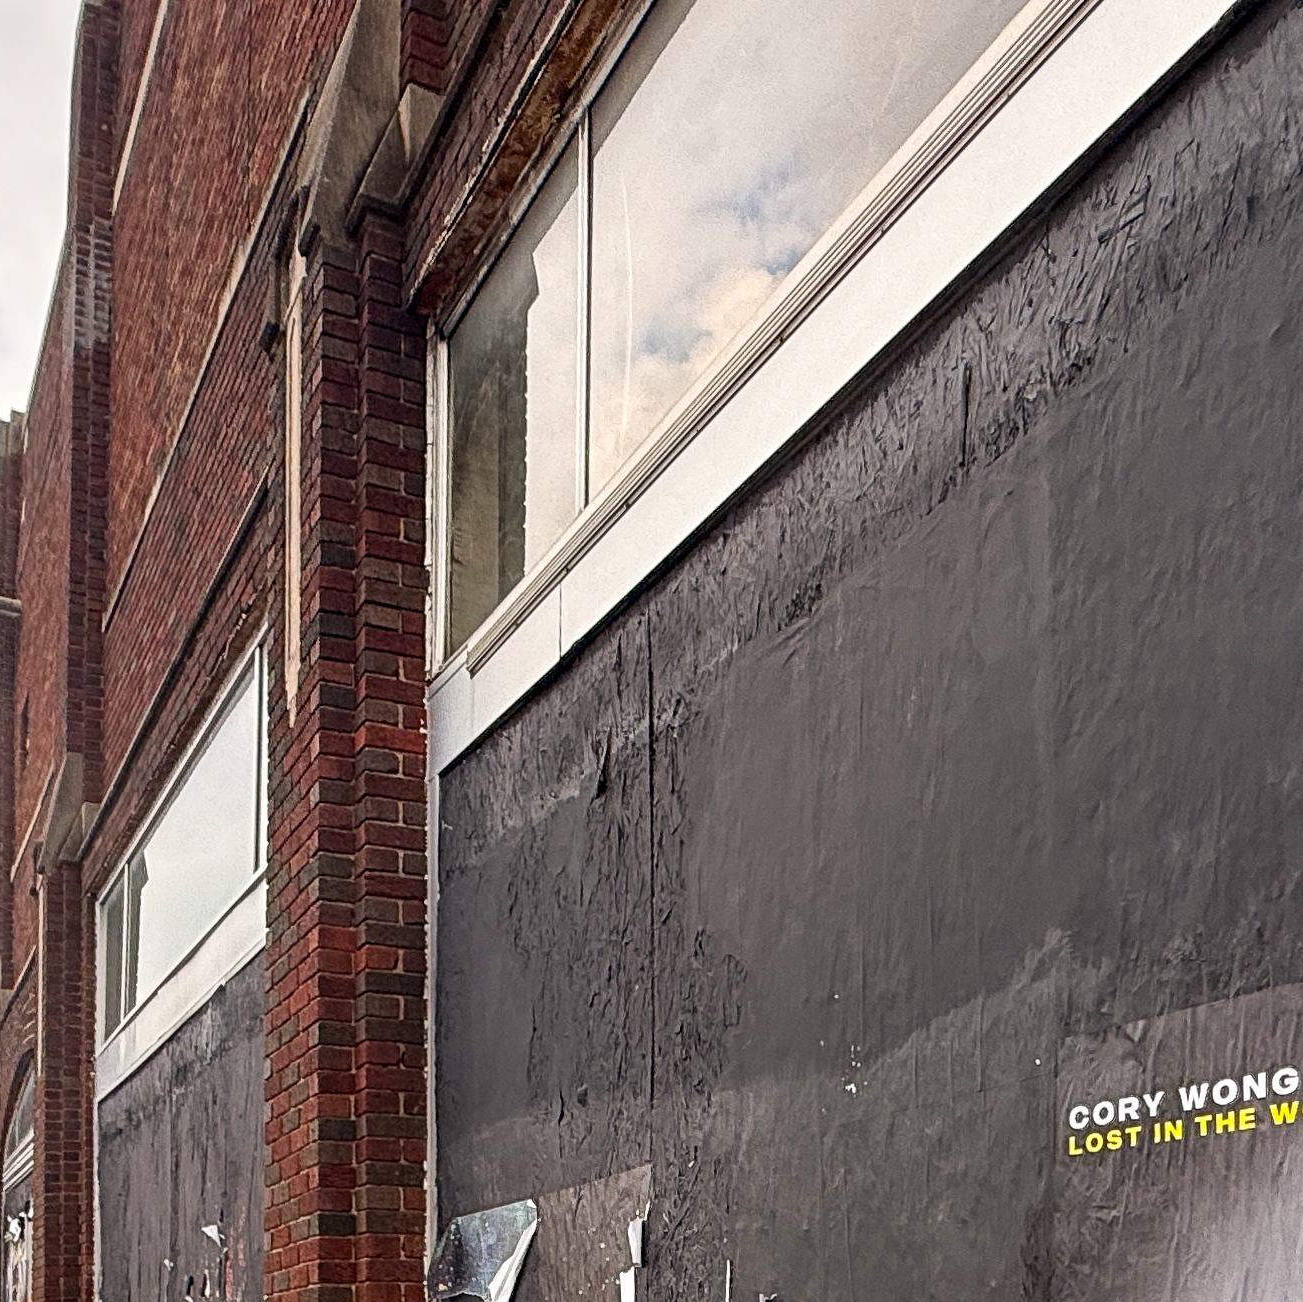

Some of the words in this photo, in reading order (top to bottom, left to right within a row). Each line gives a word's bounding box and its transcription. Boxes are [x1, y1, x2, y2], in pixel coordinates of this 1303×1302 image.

[1068, 1091, 1165, 1130] CORY
[1178, 1066, 1300, 1112] WONG
[1067, 1126, 1141, 1156] LOST
[1153, 1119, 1182, 1144] IN
[1194, 1107, 1256, 1137] THE
